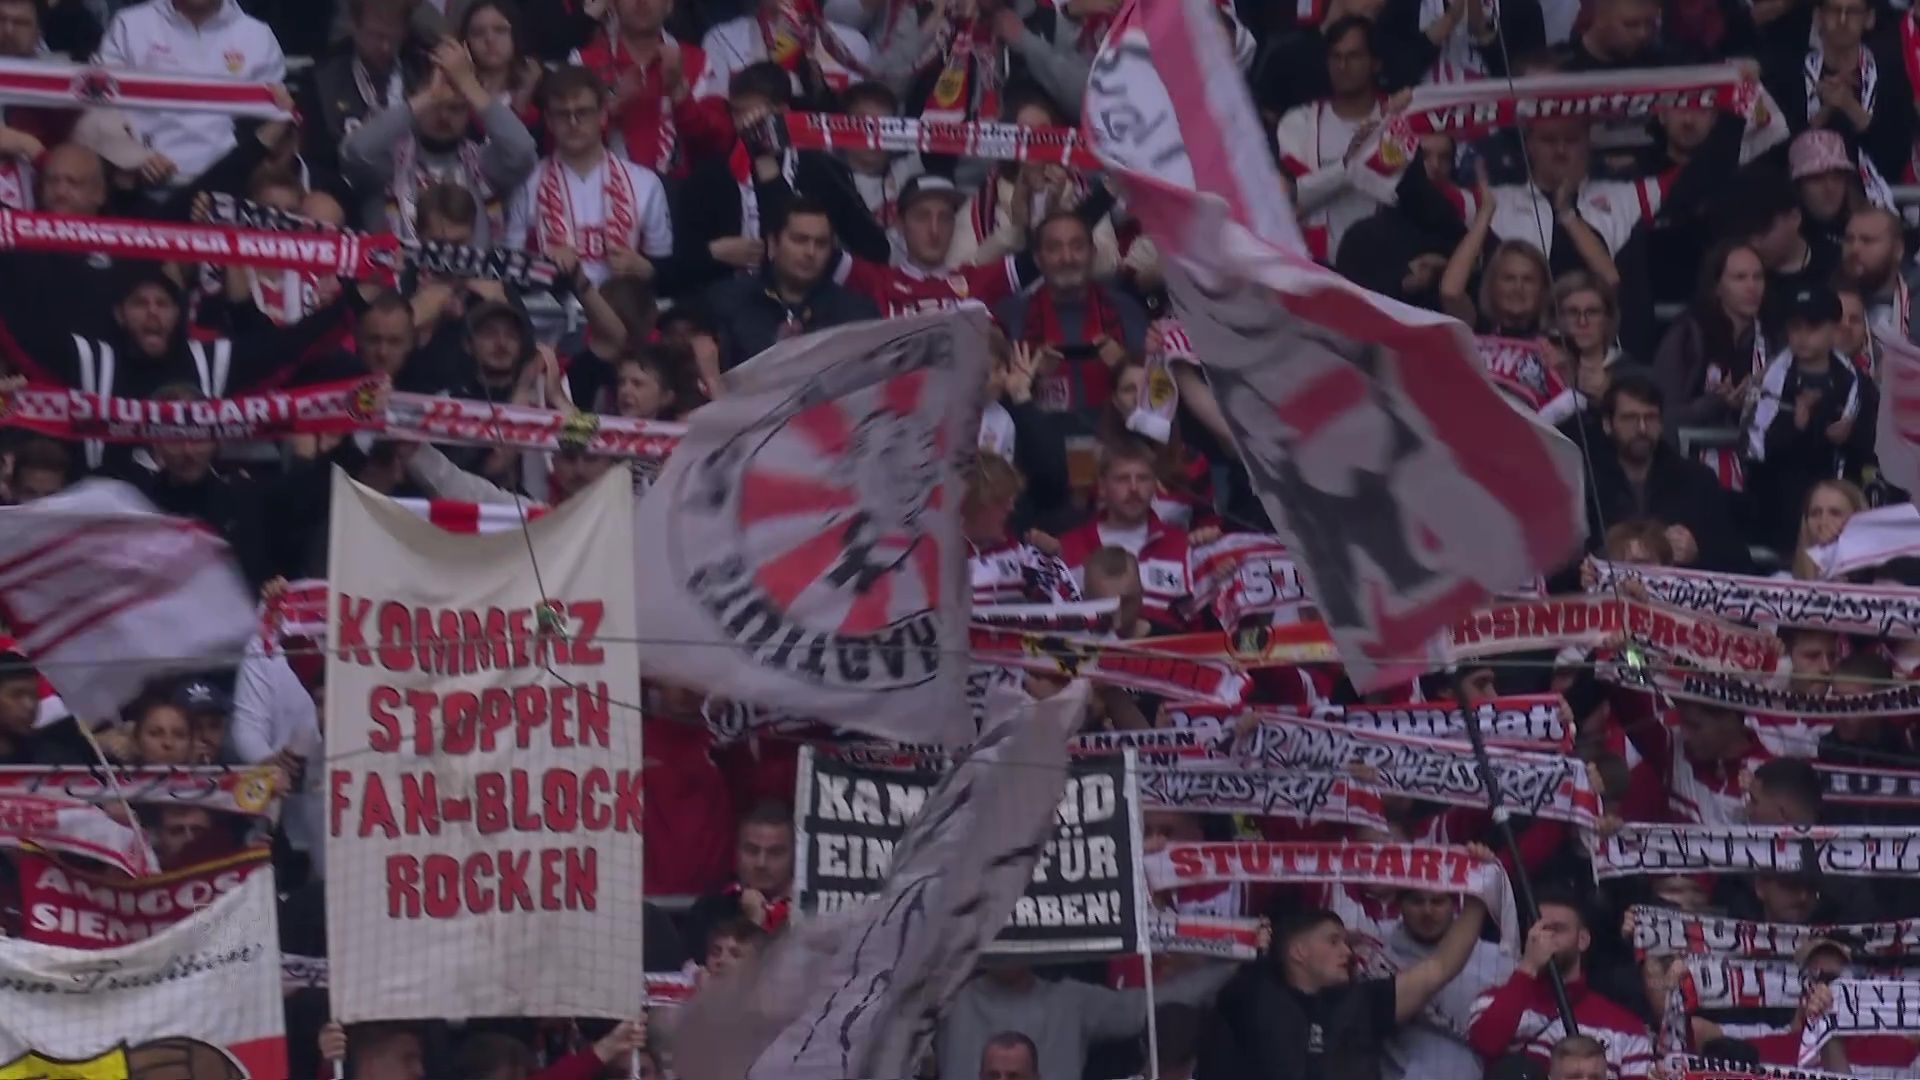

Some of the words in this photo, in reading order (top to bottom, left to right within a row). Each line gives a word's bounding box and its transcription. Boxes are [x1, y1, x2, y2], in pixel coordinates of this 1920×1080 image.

[15, 217, 231, 254] CANNSTATTER
[238, 234, 336, 264] KURVE
[337, 592, 605, 676] KOMMERZ
[368, 681, 609, 756] STOPPEN
[330, 767, 643, 839] FAN-BLOCK
[36, 867, 242, 916] AMIGOS
[386, 847, 597, 918] ROCKEN
[1170, 845, 1481, 886] STUTTGART
